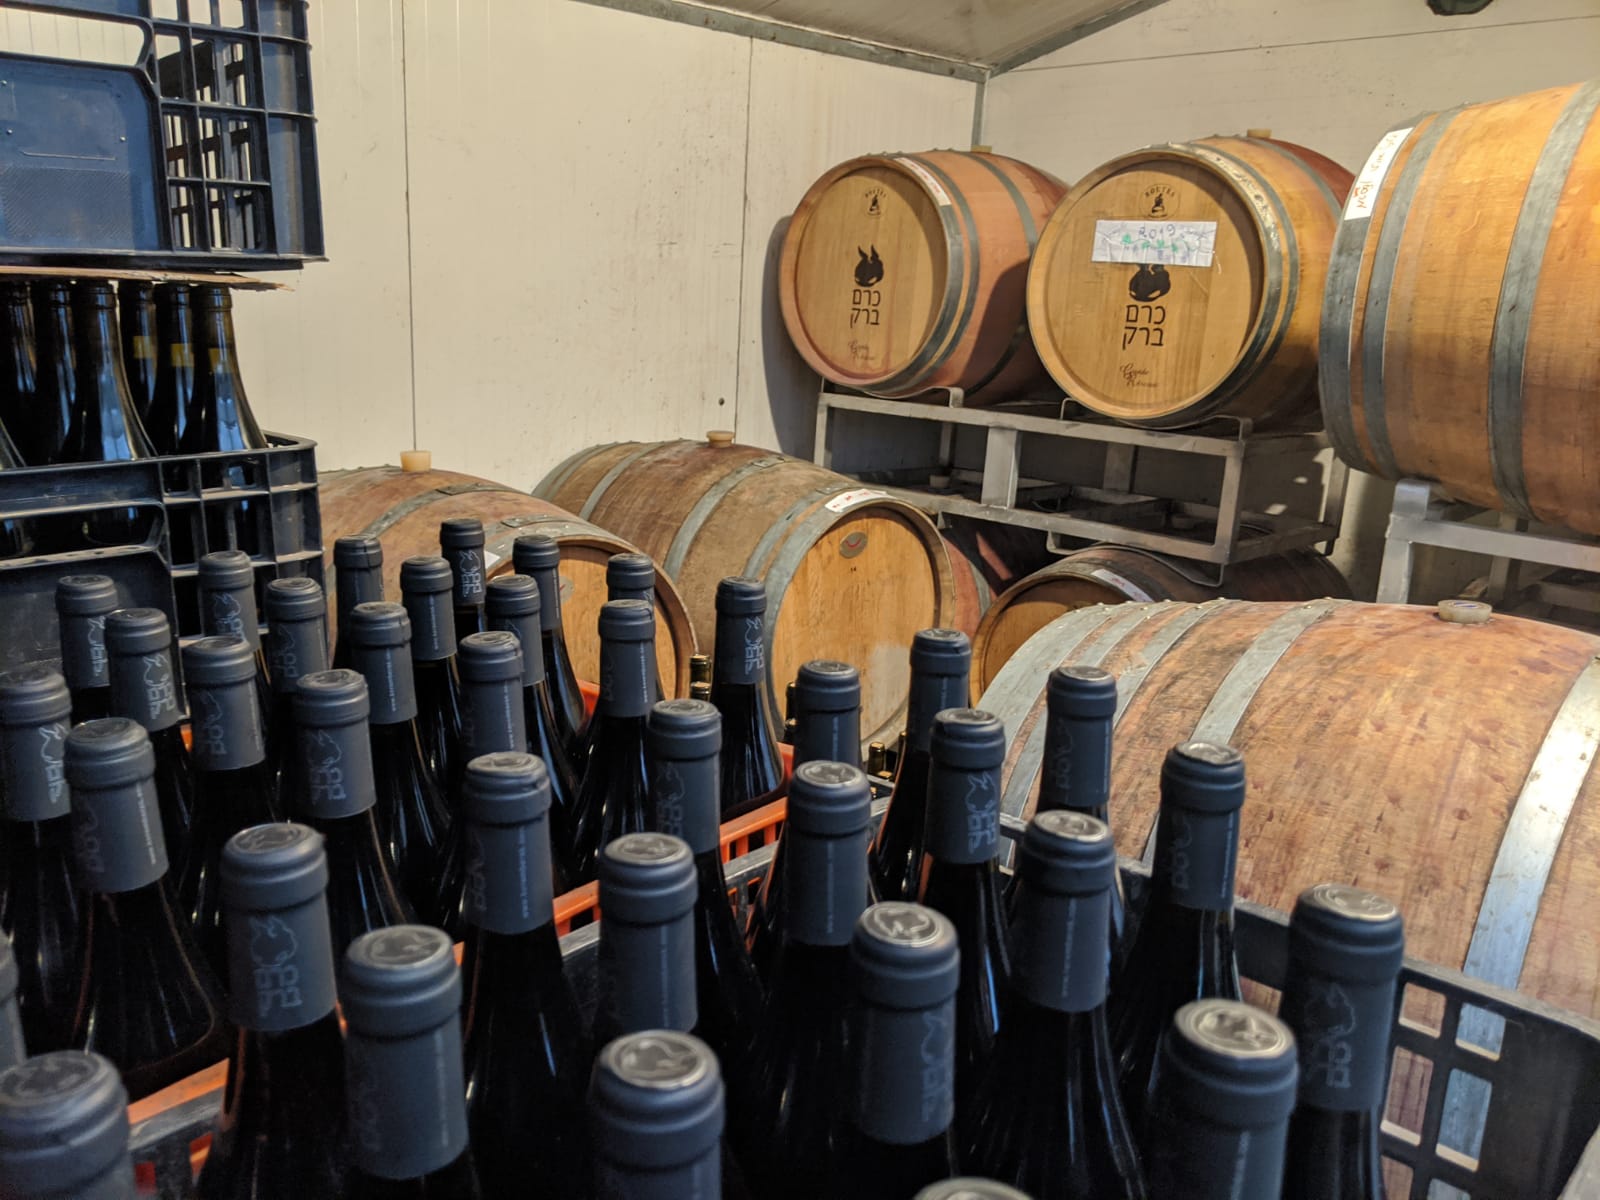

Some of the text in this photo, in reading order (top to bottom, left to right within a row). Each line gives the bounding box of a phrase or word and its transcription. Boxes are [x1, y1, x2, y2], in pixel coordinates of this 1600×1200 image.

[852, 289, 881, 307] כרם
[850, 308, 880, 328] ברק
[1126, 304, 1166, 325] כרם
[1122, 326, 1164, 351] ברק
